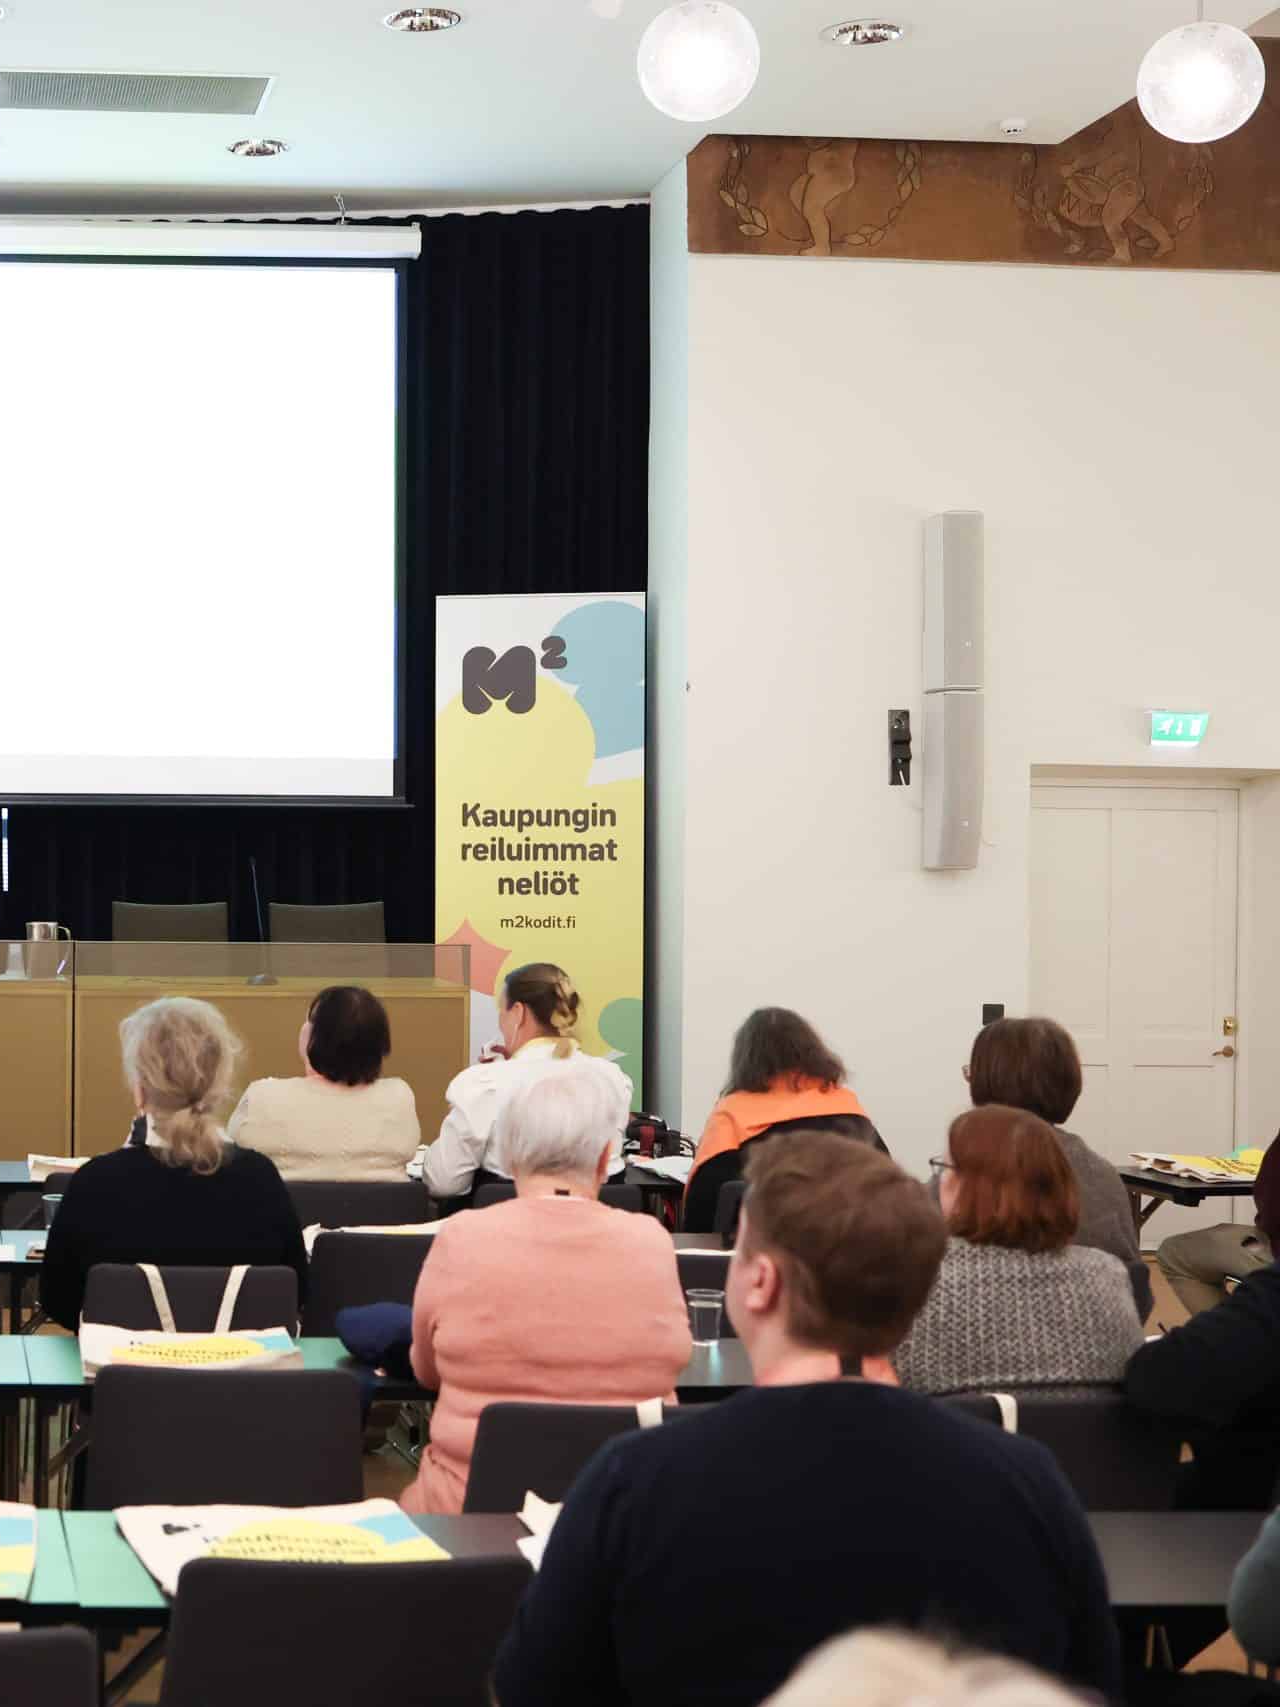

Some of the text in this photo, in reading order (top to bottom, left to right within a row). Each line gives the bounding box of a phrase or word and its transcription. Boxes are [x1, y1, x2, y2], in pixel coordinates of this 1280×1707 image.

[461, 802, 617, 833] Kaupungin
[461, 836, 618, 862] reiluimmat
[497, 870, 580, 896] neliöt
[500, 914, 577, 929] m2kodit.fi
